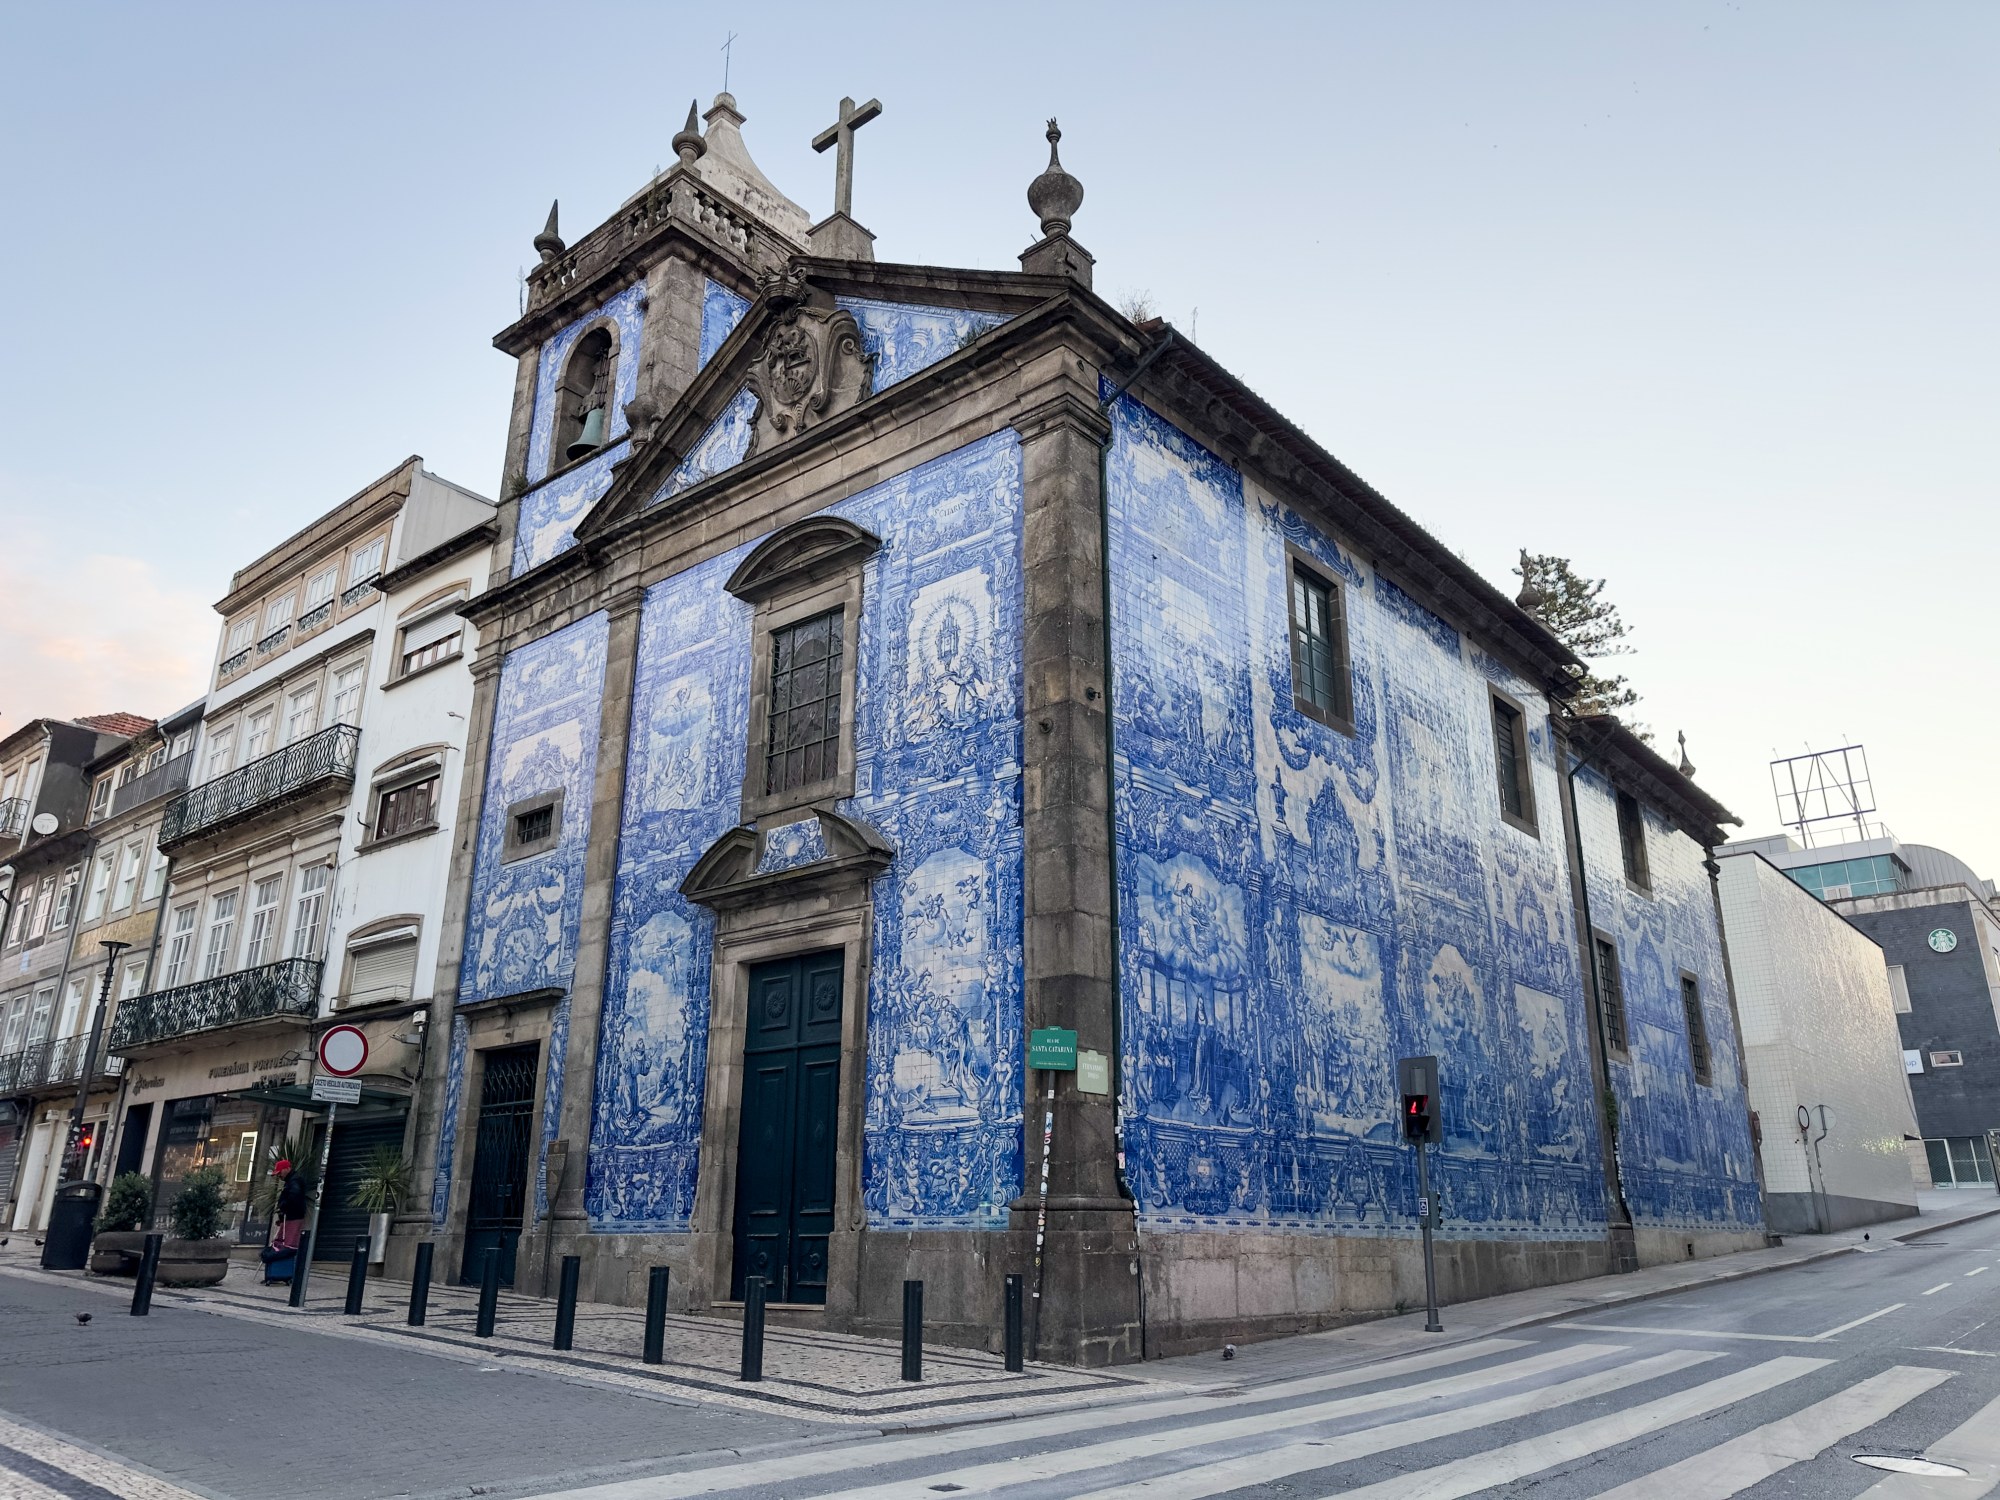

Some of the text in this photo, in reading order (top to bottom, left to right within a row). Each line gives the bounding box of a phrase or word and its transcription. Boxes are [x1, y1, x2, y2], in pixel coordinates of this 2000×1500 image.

[1031, 1045, 1073, 1053] SANTA CATARINA
[208, 1061, 250, 1079] FUNERÁRIA
